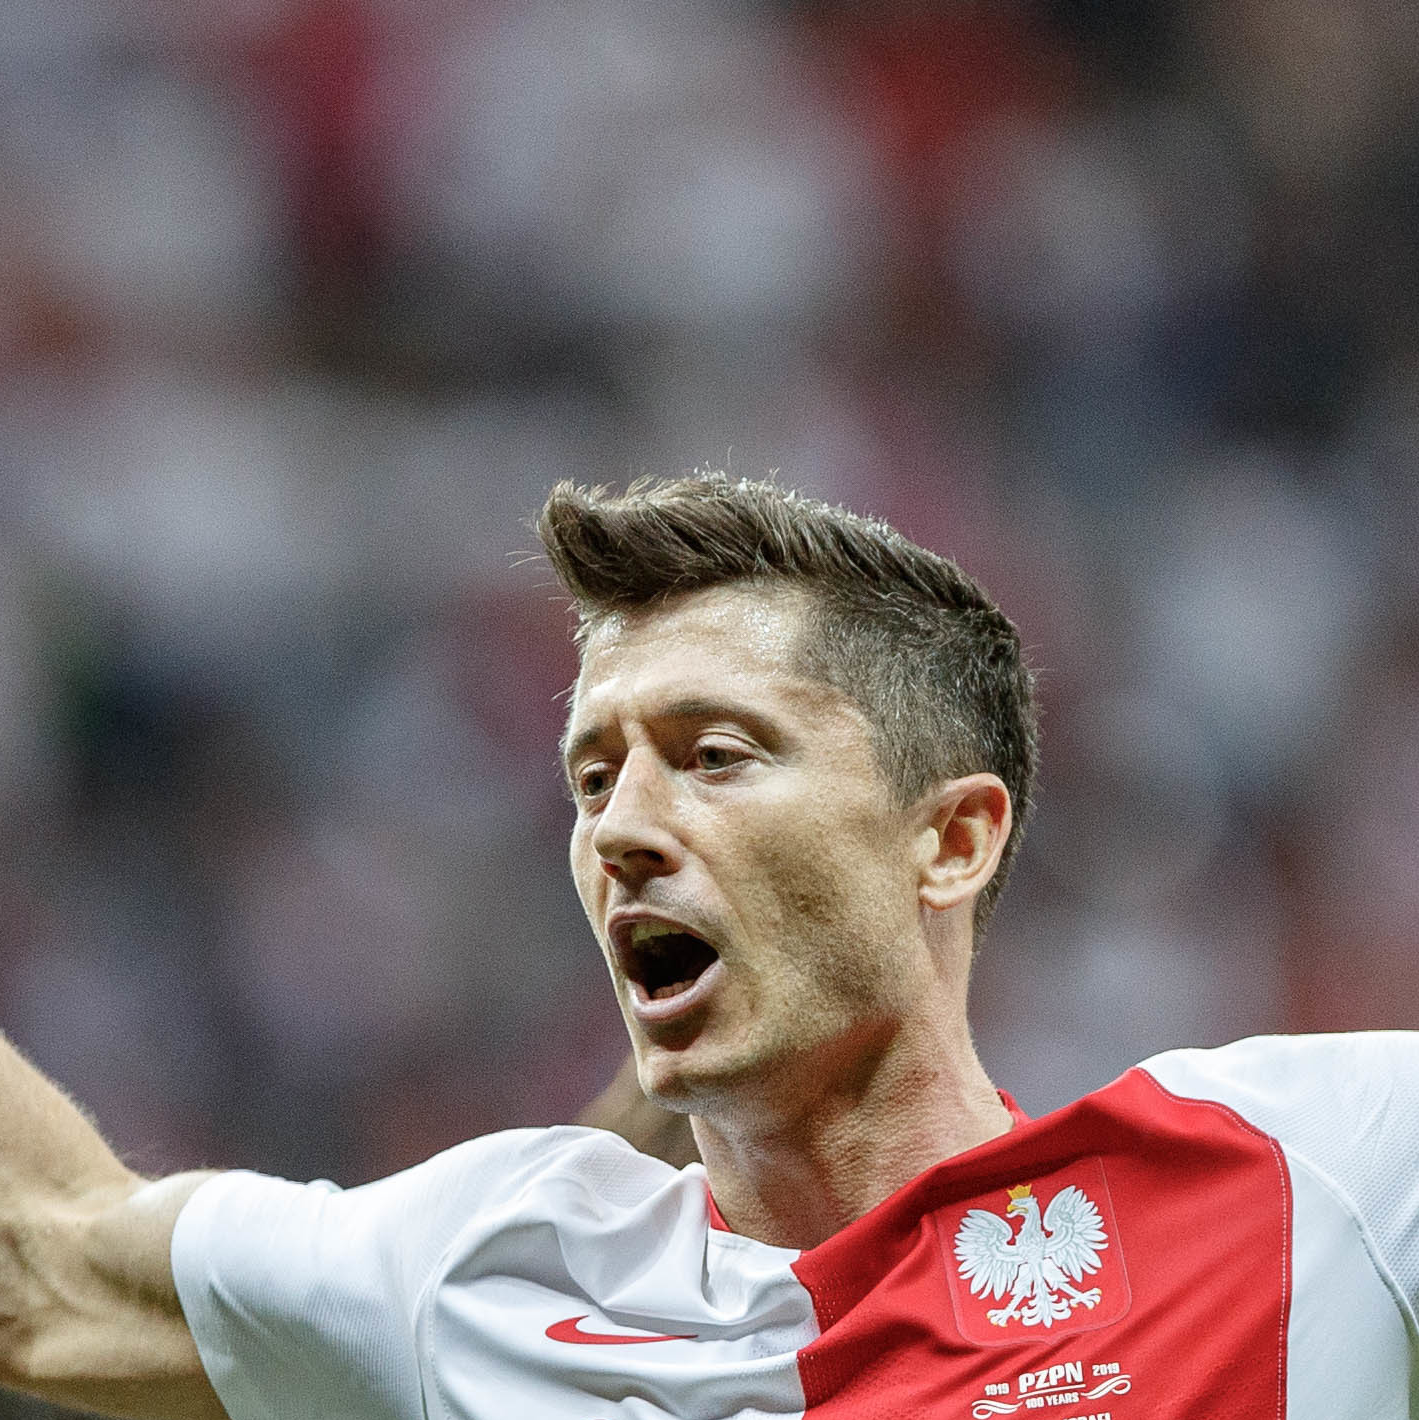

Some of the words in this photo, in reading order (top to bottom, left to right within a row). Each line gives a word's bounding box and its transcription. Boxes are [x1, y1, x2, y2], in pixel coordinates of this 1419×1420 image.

[984, 1382, 1010, 1396] 1919
[1017, 1360, 1084, 1393] PZPN
[1092, 1362, 1121, 1377] 2019
[1025, 1396, 1045, 1409] 100
[1047, 1392, 1080, 1406] YEARS
